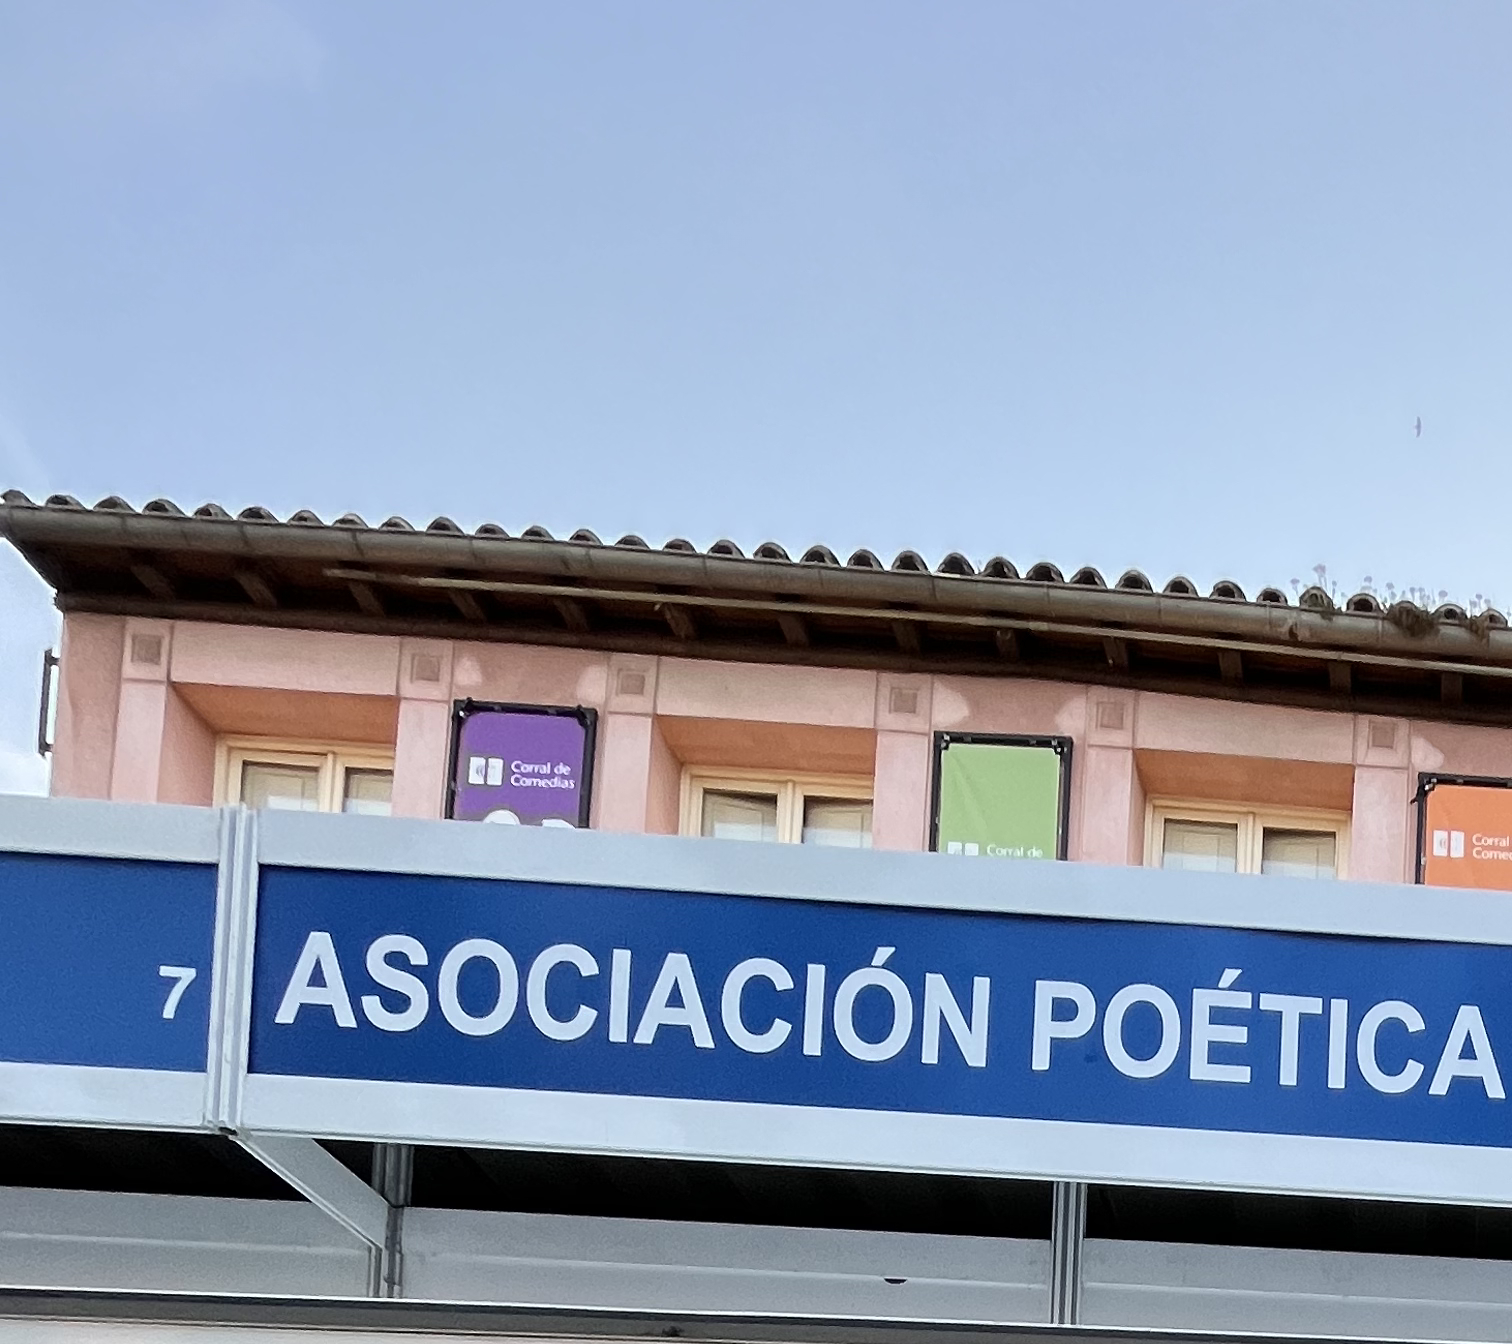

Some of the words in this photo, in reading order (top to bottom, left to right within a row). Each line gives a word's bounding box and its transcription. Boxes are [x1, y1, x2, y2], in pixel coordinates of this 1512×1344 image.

[511, 760, 551, 775] Corral
[554, 762, 571, 776] de
[510, 774, 576, 790] Comedias
[1472, 833, 1510, 847] Corral
[987, 843, 1025, 857] Corral
[158, 965, 197, 1019] 7
[274, 931, 991, 1068] ASOCIACIÓN
[1031, 968, 1506, 1099] POÉTICA
